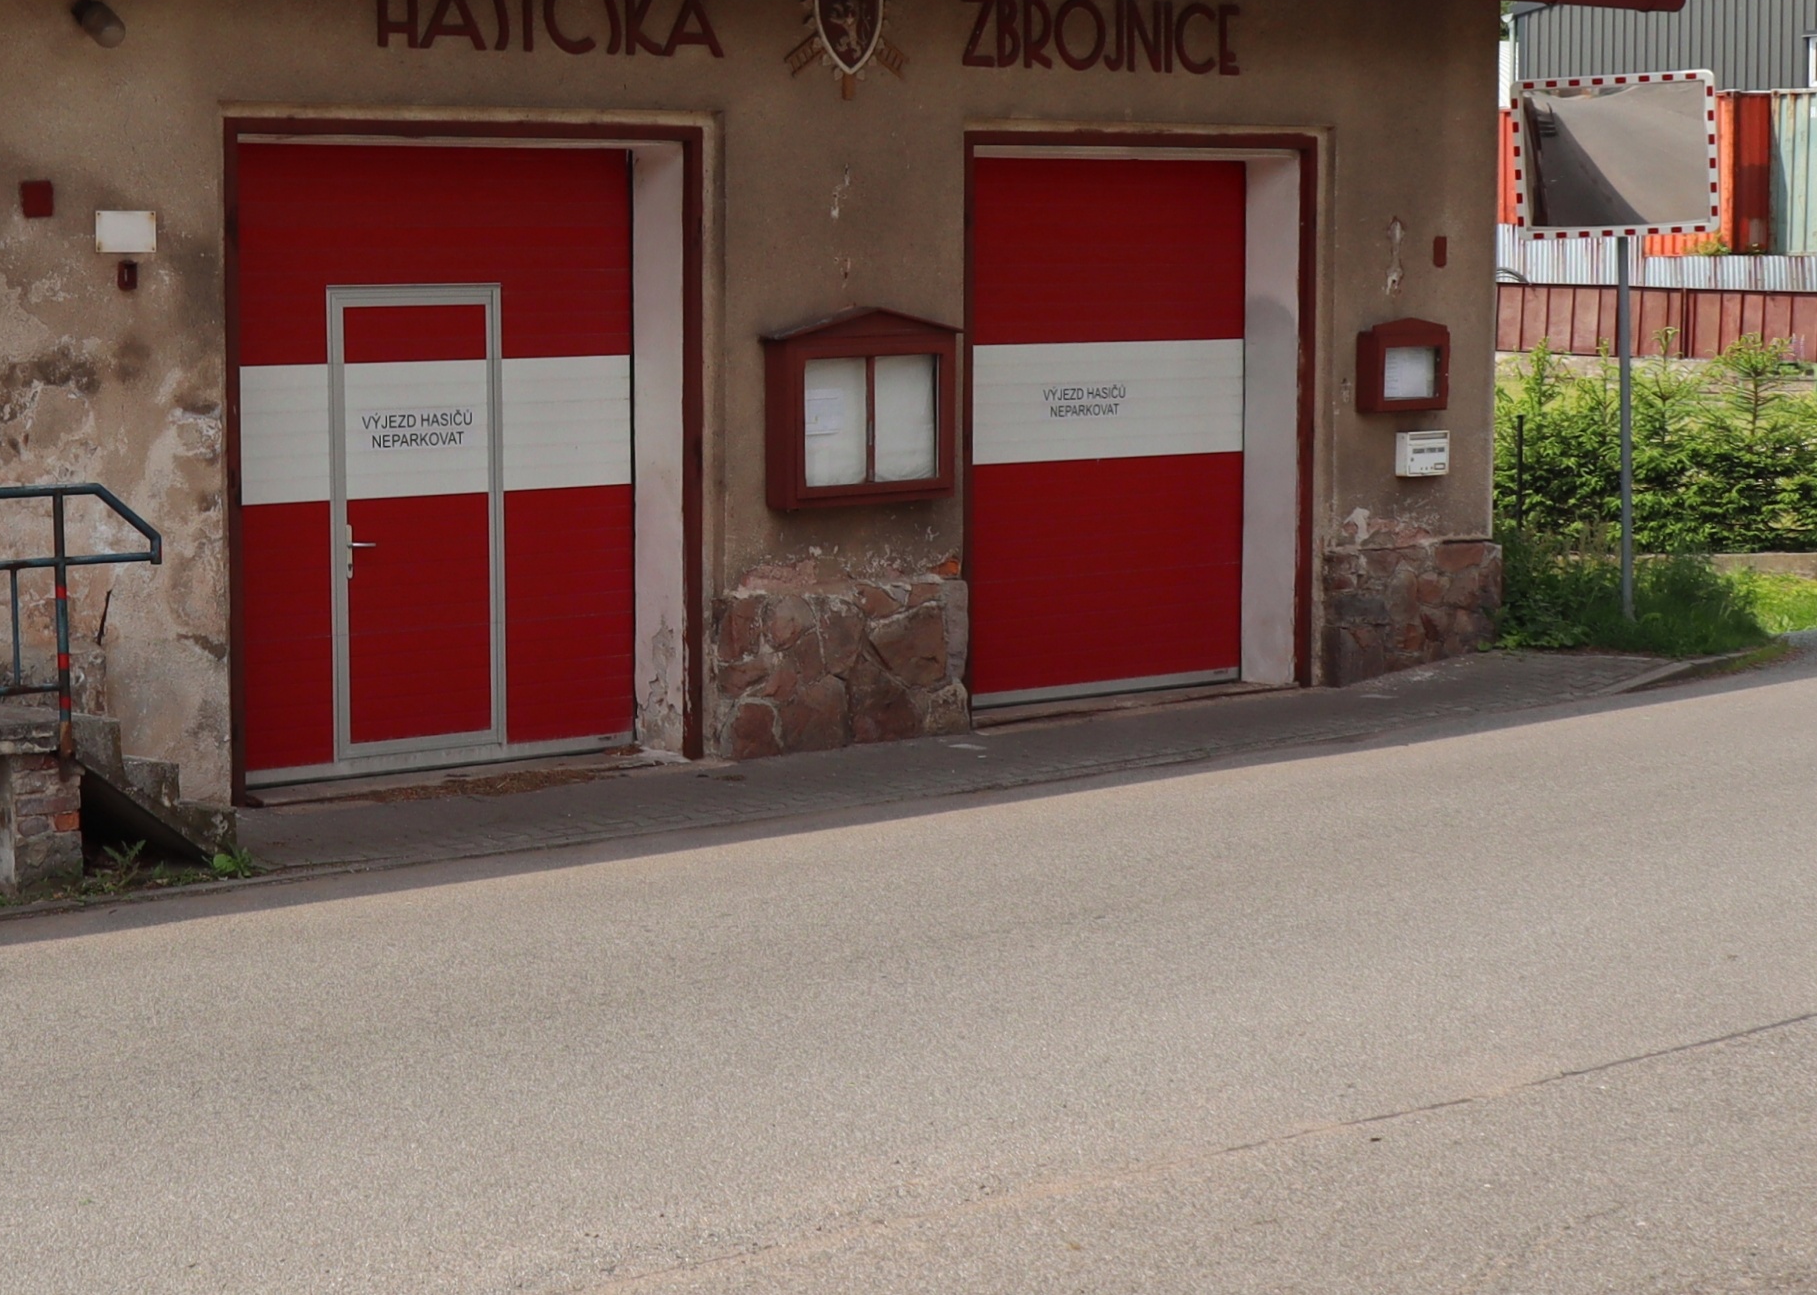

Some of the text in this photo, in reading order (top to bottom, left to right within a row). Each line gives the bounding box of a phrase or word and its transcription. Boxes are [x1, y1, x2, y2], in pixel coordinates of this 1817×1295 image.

[1043, 384, 1126, 401] VÝJEZD HASIČŮ
[1049, 403, 1120, 418] NEPARKOVAT
[362, 409, 473, 430] VÝJEZD HASIČŮ
[371, 431, 464, 449] NEPARKOVAT
